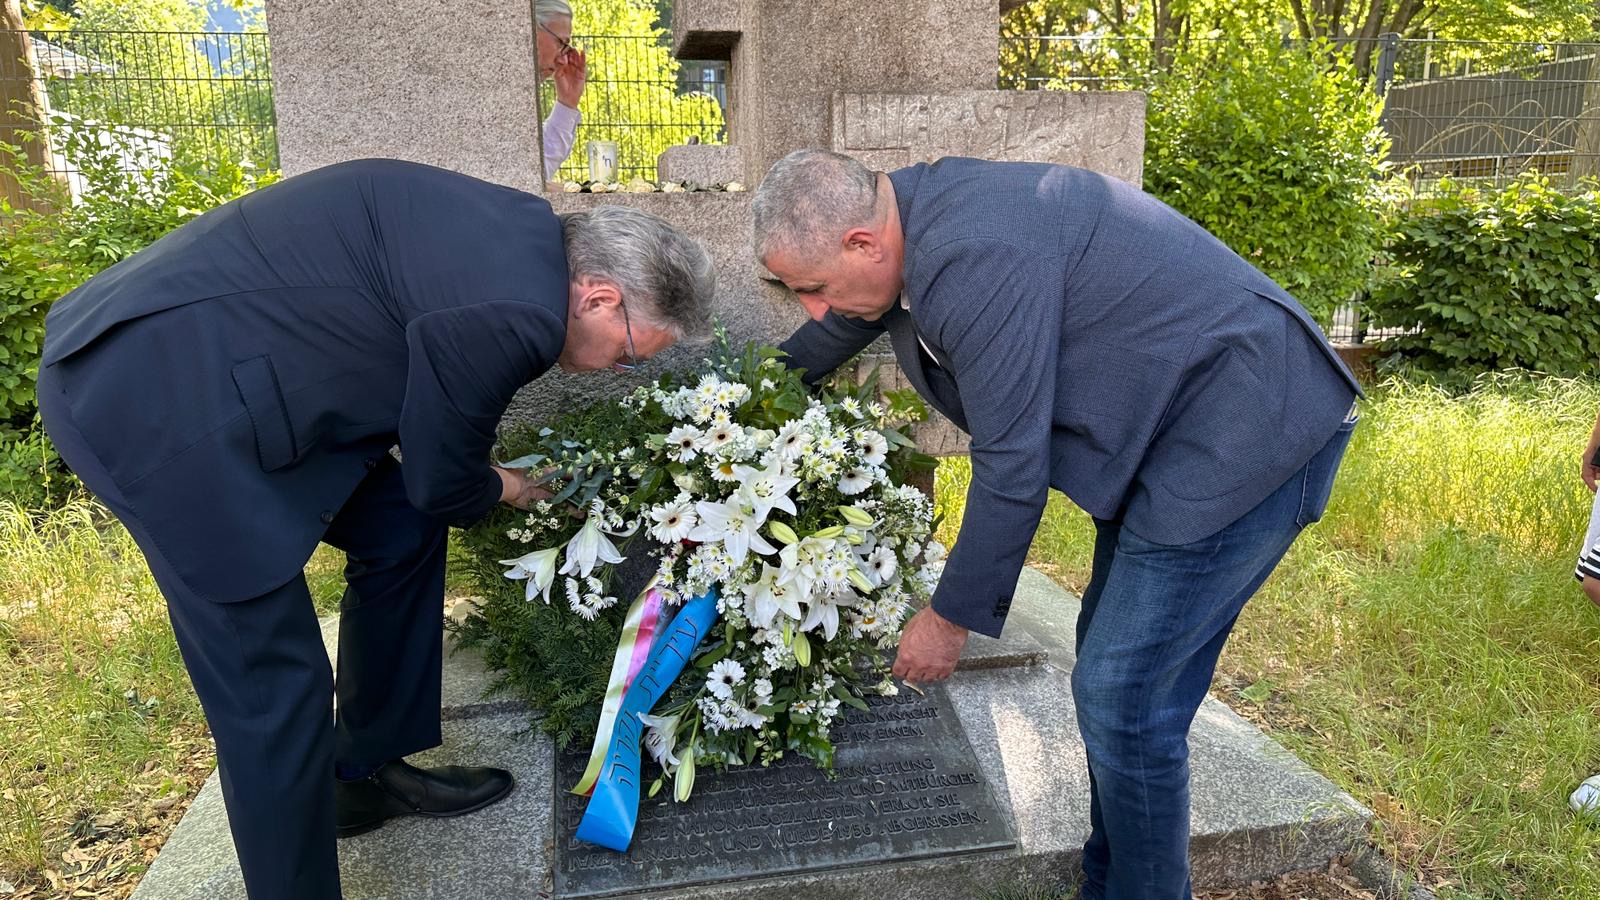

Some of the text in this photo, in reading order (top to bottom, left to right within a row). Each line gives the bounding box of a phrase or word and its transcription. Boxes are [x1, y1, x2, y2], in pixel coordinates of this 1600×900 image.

[877, 725, 926, 741] EINEM
[848, 778, 886, 799] UND
[888, 772, 980, 795] MITBÜRGER
[936, 793, 961, 809] SIE
[721, 834, 762, 854] UND
[837, 822, 874, 842] 1956
